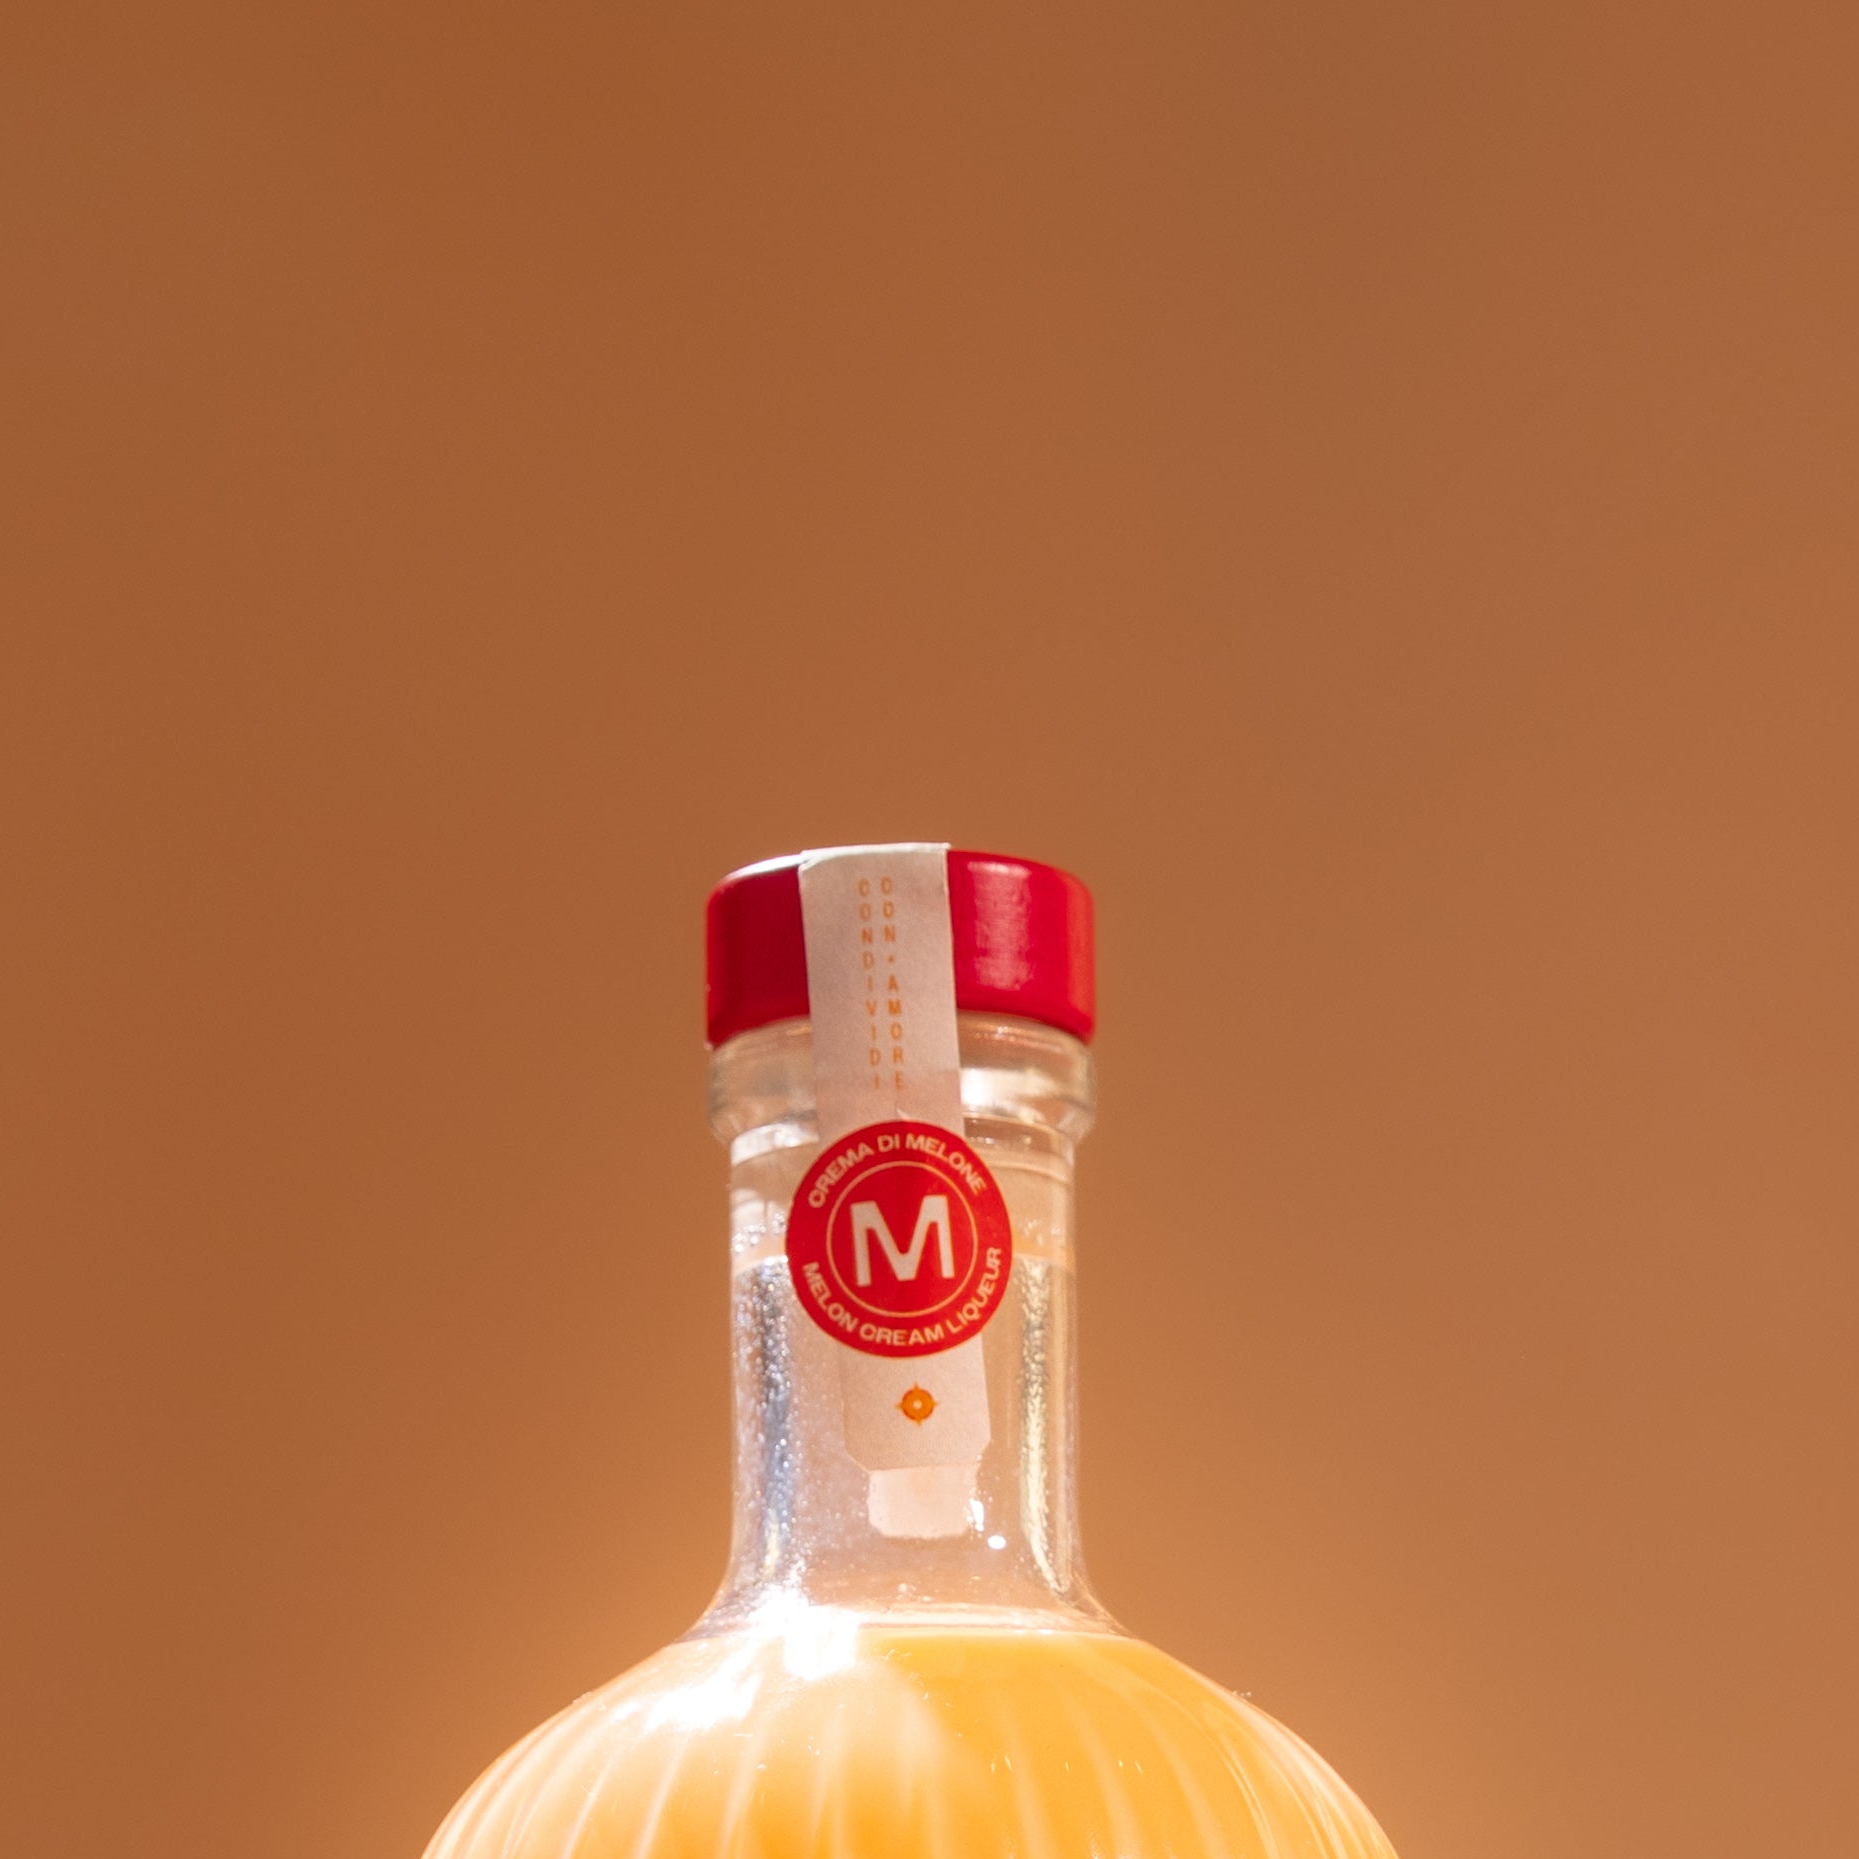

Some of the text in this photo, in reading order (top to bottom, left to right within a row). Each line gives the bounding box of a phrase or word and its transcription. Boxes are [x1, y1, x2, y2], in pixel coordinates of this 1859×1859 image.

[888, 976, 904, 1089] AMORE
[808, 1133, 986, 1208] CREMA DI MELONE
[851, 1194, 955, 1286] M
[803, 1247, 1002, 1346] MELON CREAM LIQUEUR
